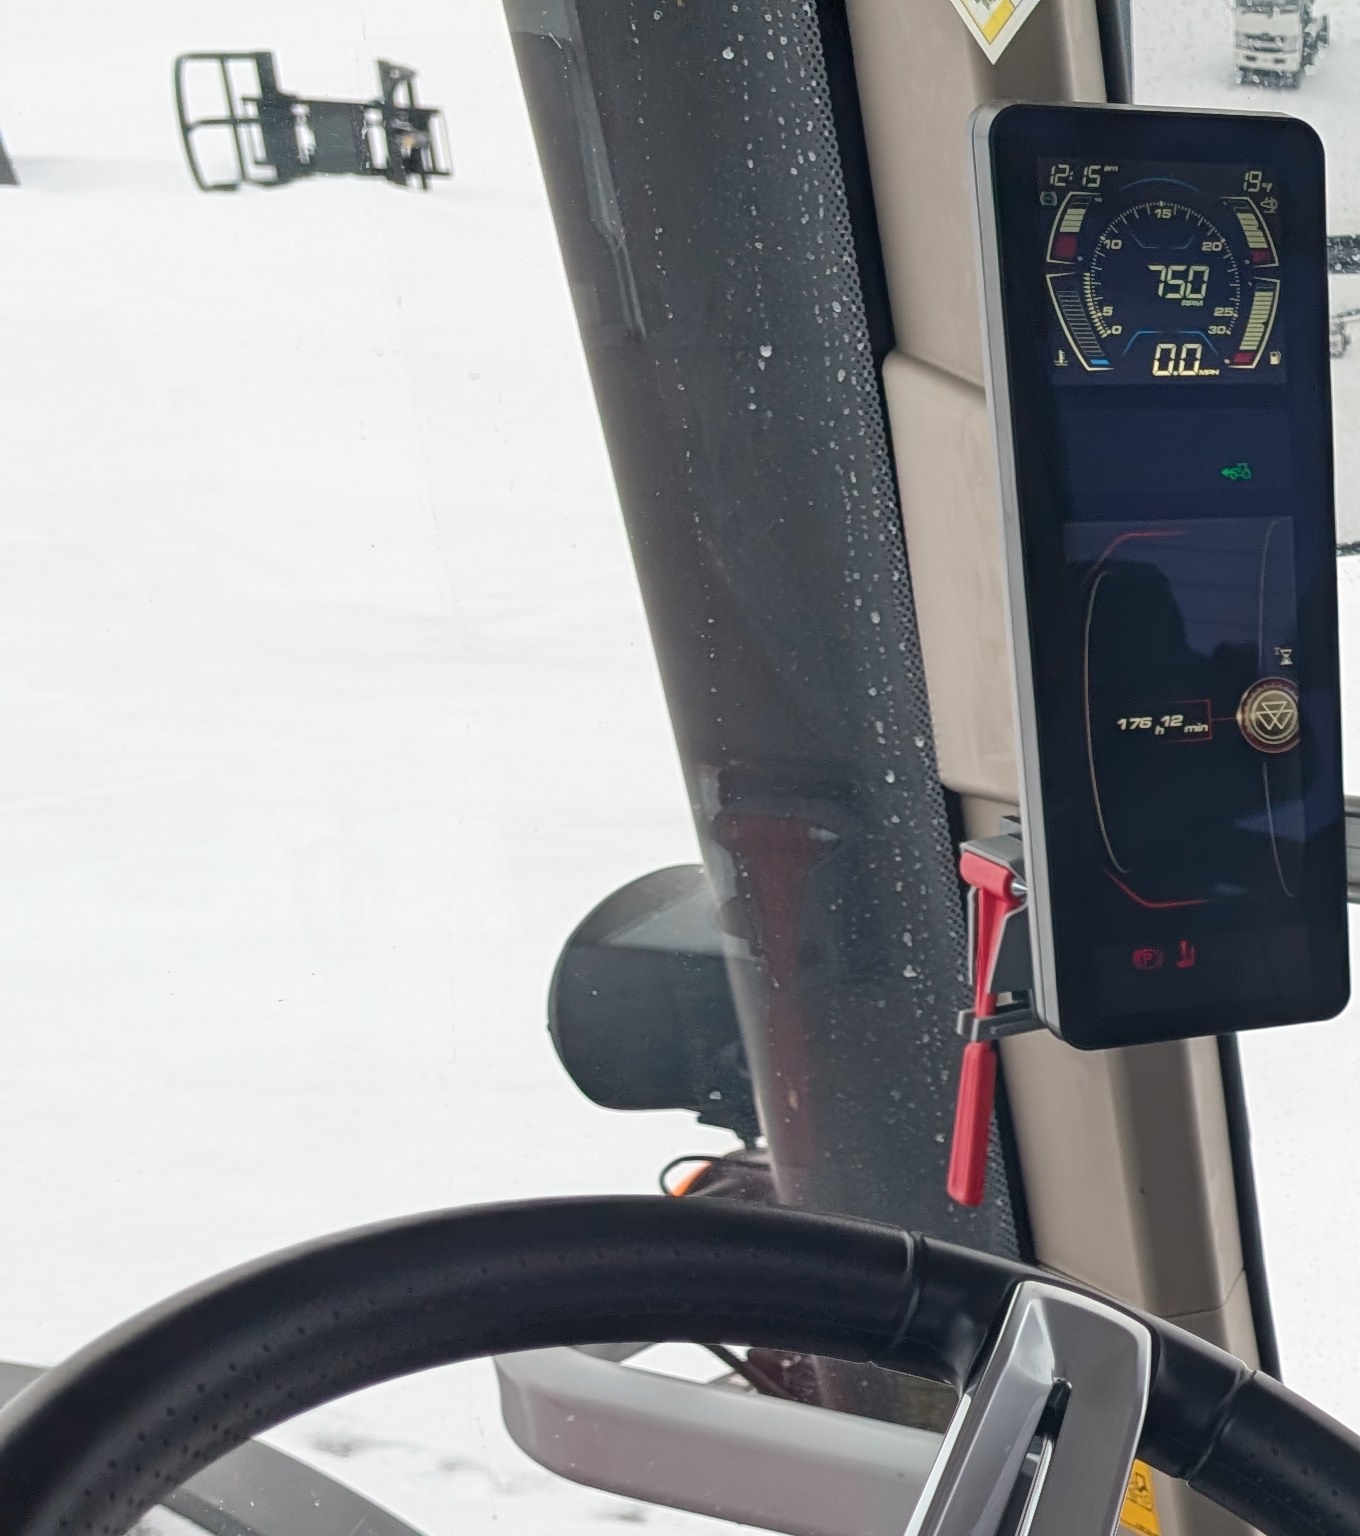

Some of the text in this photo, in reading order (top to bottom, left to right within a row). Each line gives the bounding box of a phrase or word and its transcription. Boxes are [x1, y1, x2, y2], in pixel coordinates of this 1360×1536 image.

[1050, 164, 1101, 187] 12:15
[1243, 170, 1262, 192] 19
[1154, 208, 1172, 219] 15
[1104, 239, 1122, 250] 10
[1202, 241, 1223, 252] 20
[1147, 265, 1210, 299] 750
[1102, 306, 1114, 317] 5
[1213, 307, 1234, 317] 25
[1111, 325, 1123, 335] 0
[1207, 325, 1227, 335] 30
[1152, 343, 1203, 377] 0.0
[1117, 716, 1153, 731] 176
[1160, 714, 1184, 728] 12
[1183, 722, 1209, 733] min
